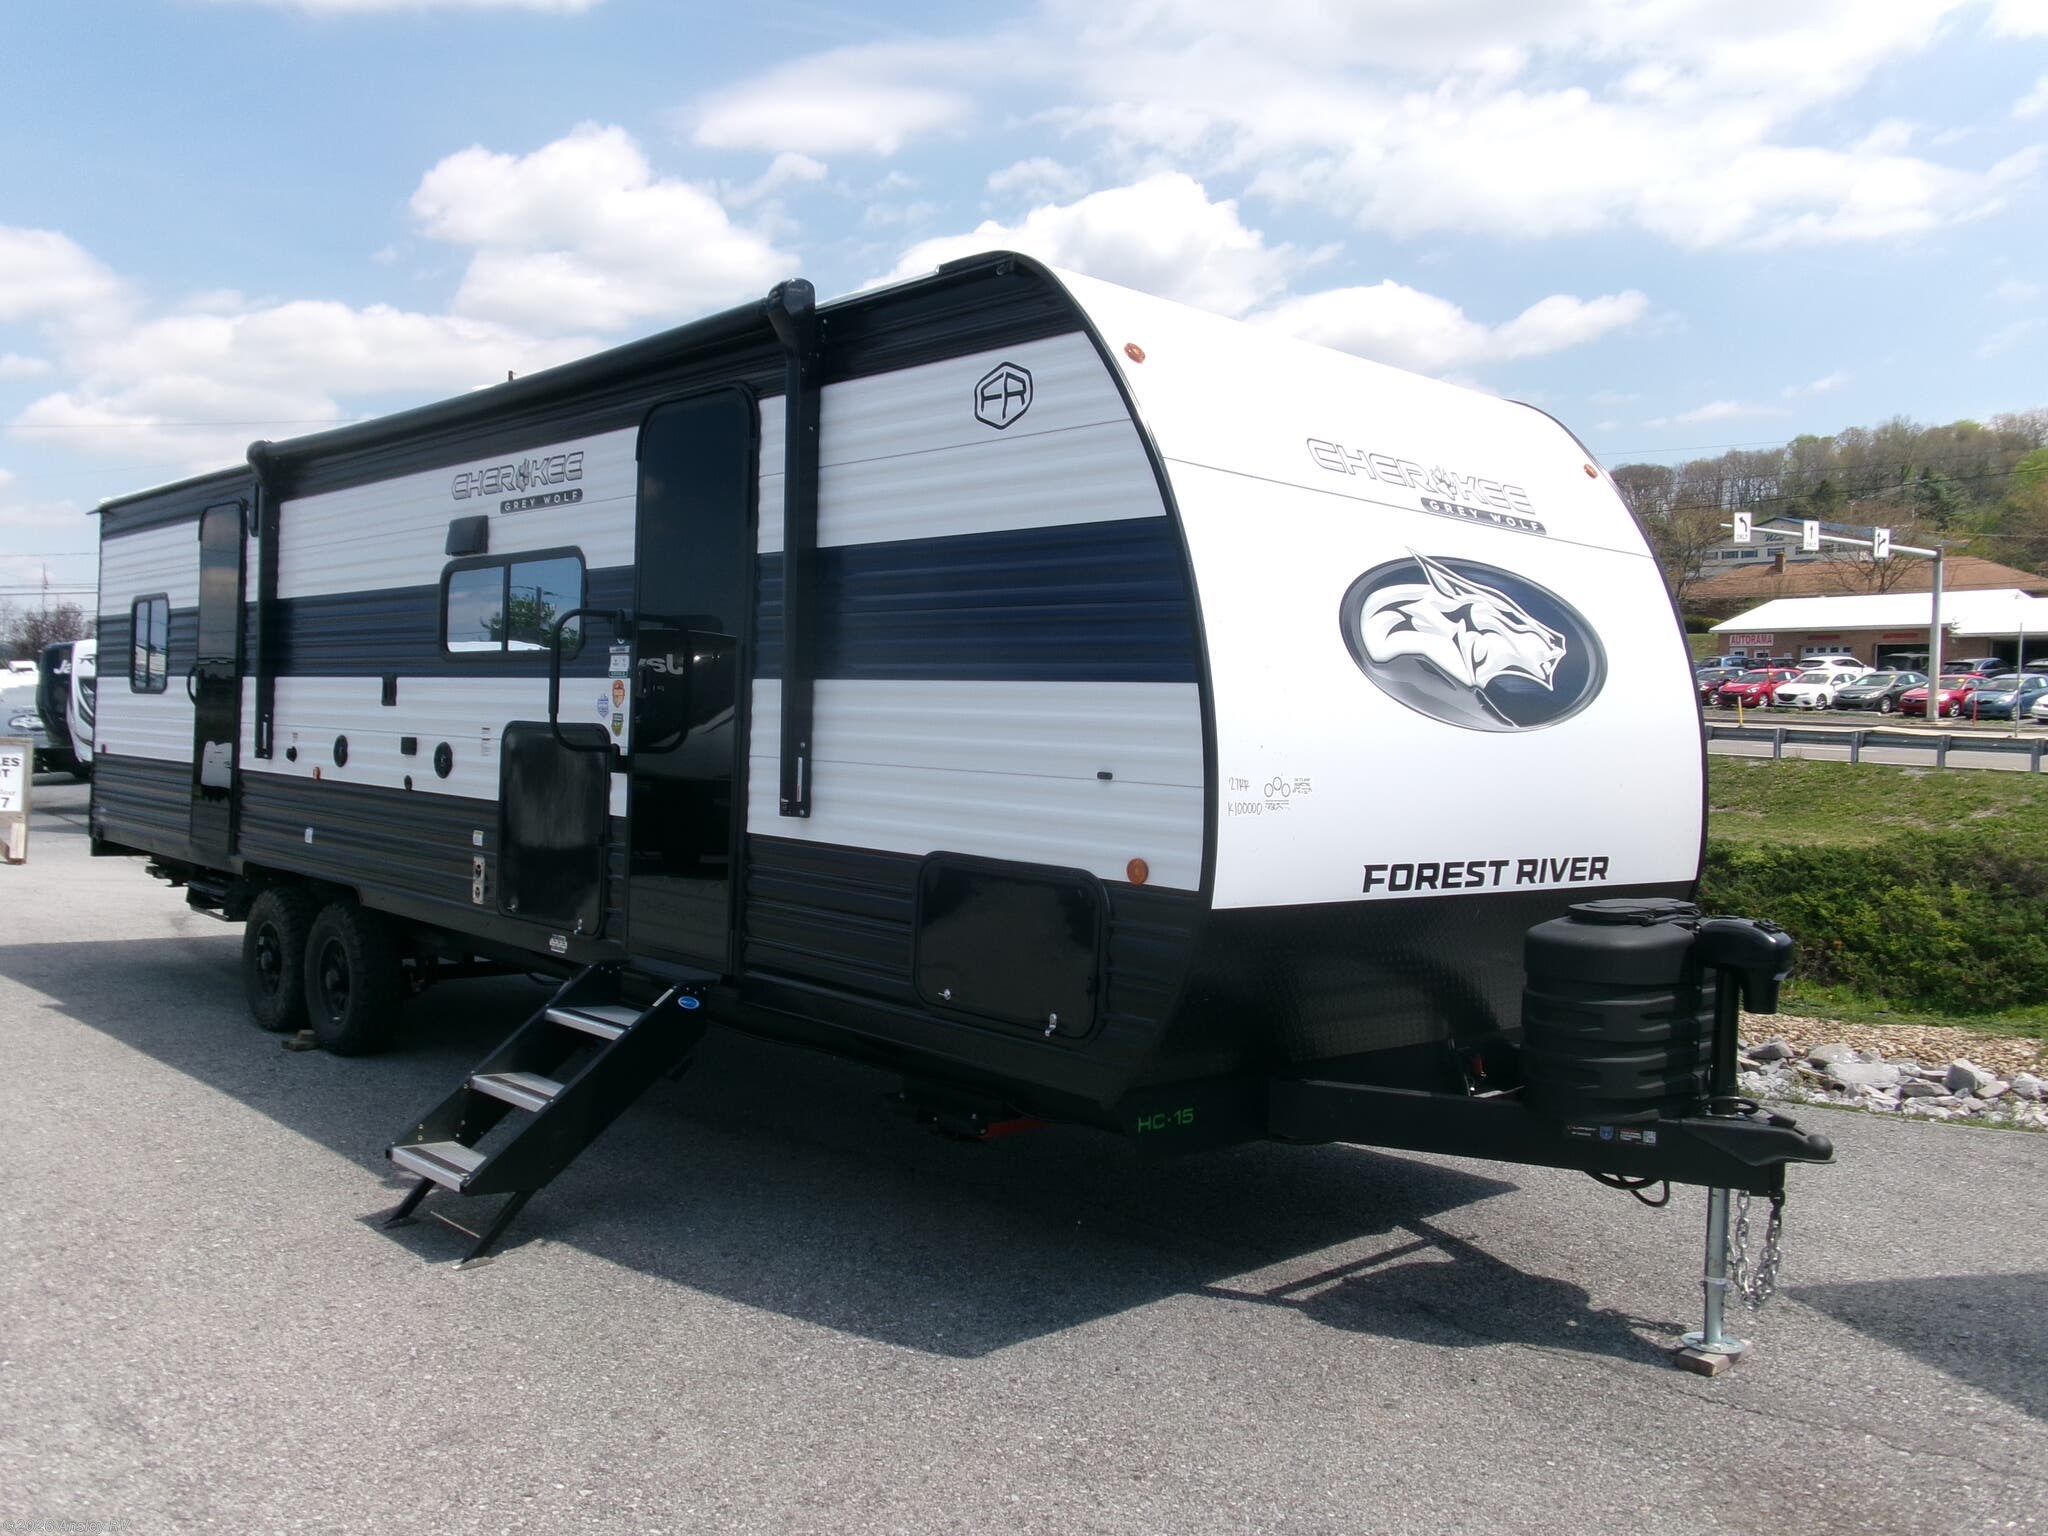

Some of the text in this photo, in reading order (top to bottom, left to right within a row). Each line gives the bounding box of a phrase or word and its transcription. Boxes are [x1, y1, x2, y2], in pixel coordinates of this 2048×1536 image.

[505, 490, 578, 511] GREY WOLF
[1429, 499, 1539, 531] GREY WOLF
[1731, 635, 1773, 645] AUTORAMA
[0, 757, 20, 767] ES
[1363, 856, 1609, 893] FOREST RIVER
